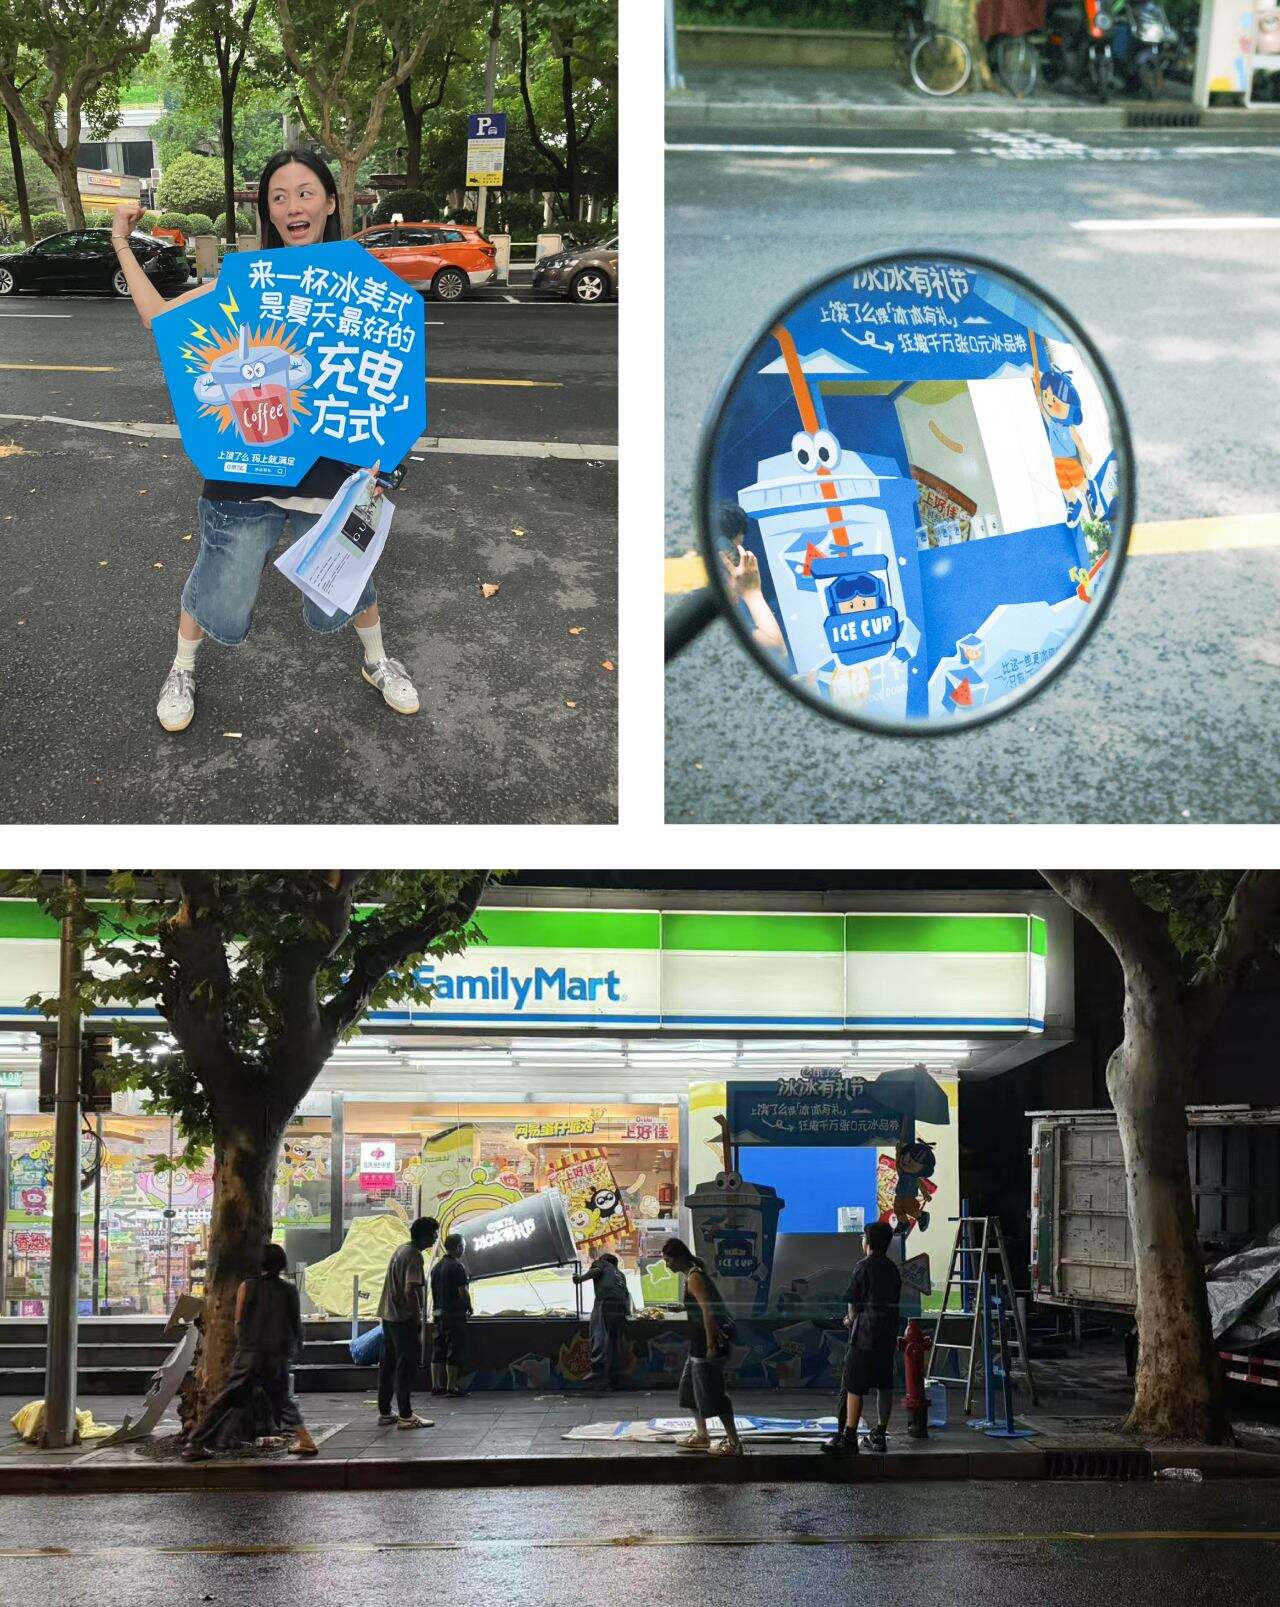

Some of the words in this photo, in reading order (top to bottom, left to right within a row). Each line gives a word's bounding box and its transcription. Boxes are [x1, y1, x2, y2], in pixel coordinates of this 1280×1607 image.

[476, 117, 492, 136] P
[248, 259, 414, 322] 来一杯冰美式
[259, 291, 415, 353] 是夏天最好的
[307, 331, 409, 412] 「充电」
[243, 402, 284, 435] Coffee
[309, 394, 387, 446] 方式
[831, 620, 858, 643] ICE
[860, 615, 892, 638] CUP
[777, 1078, 865, 1100] 冰冰有礼节
[621, 1124, 669, 1140] 上好佳
